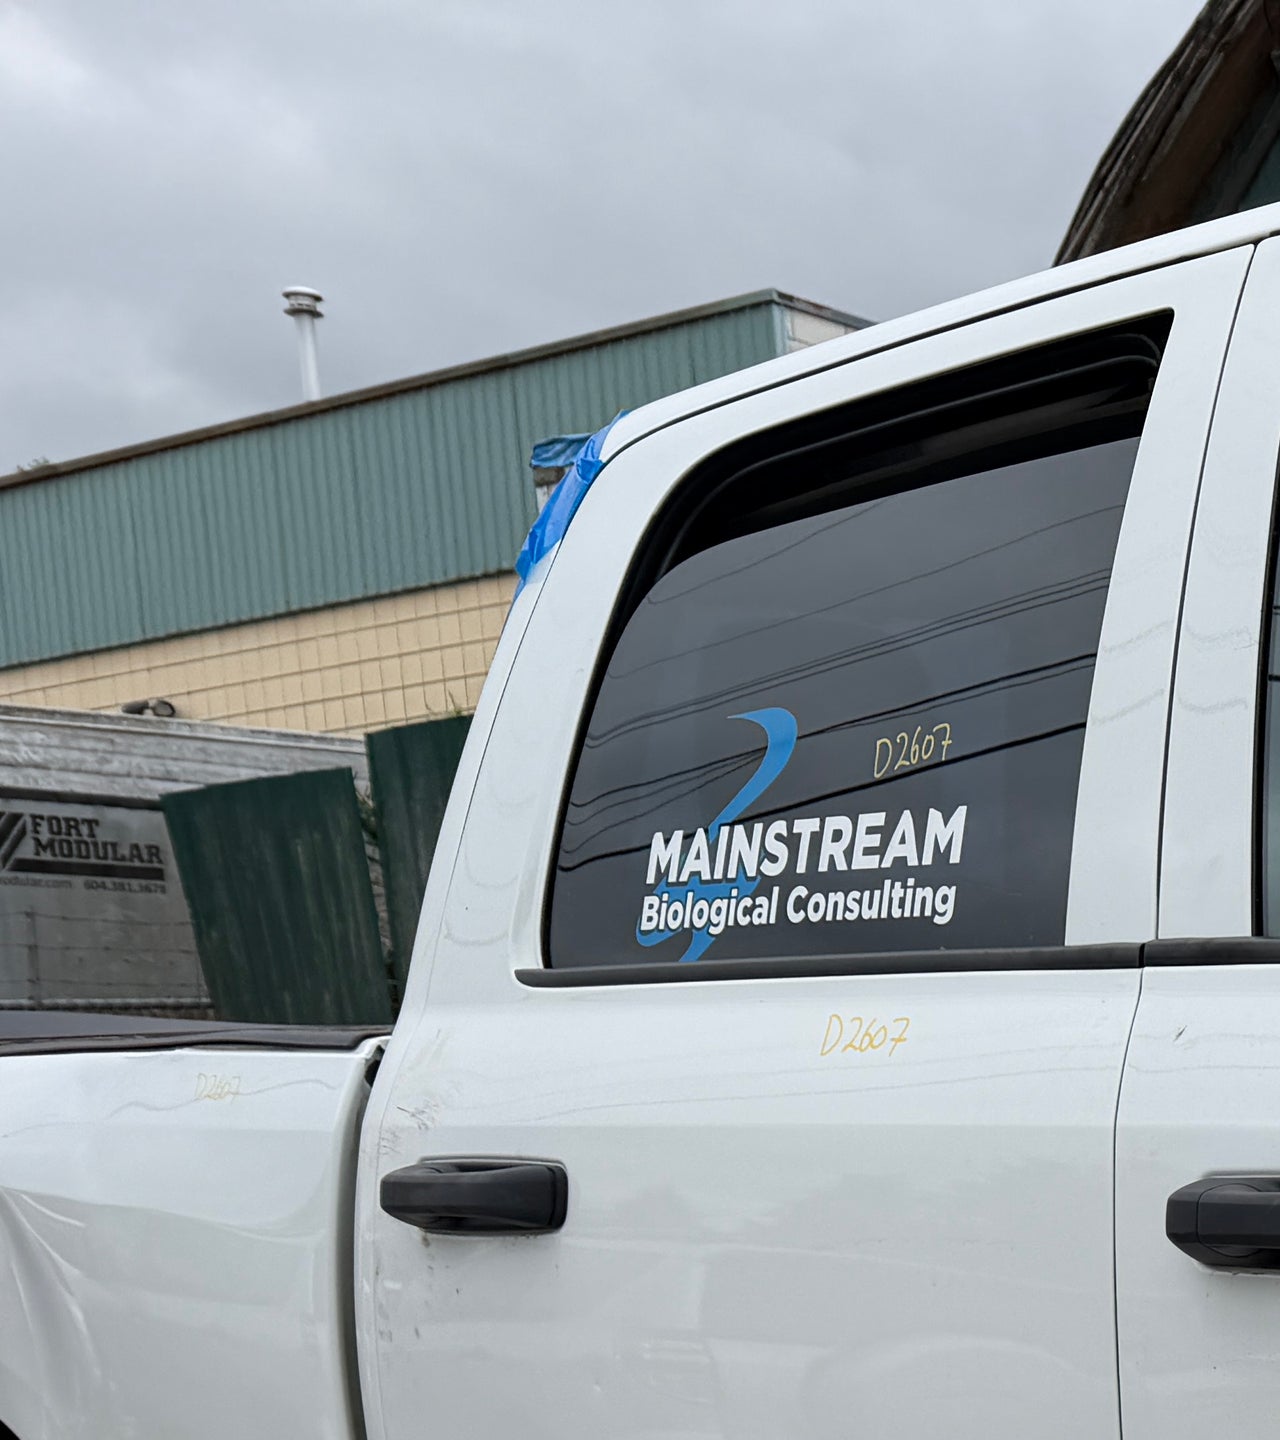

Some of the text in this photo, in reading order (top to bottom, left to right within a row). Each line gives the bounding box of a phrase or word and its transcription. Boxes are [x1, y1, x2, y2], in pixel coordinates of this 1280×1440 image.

[873, 722, 953, 779] D2607
[30, 814, 100, 839] FORT
[645, 804, 968, 885] MAINSTREAM
[33, 837, 164, 865] MODULAR
[0, 876, 73, 891] odular.com
[639, 878, 957, 936] Biological Consulting
[818, 1013, 911, 1058] D2607
